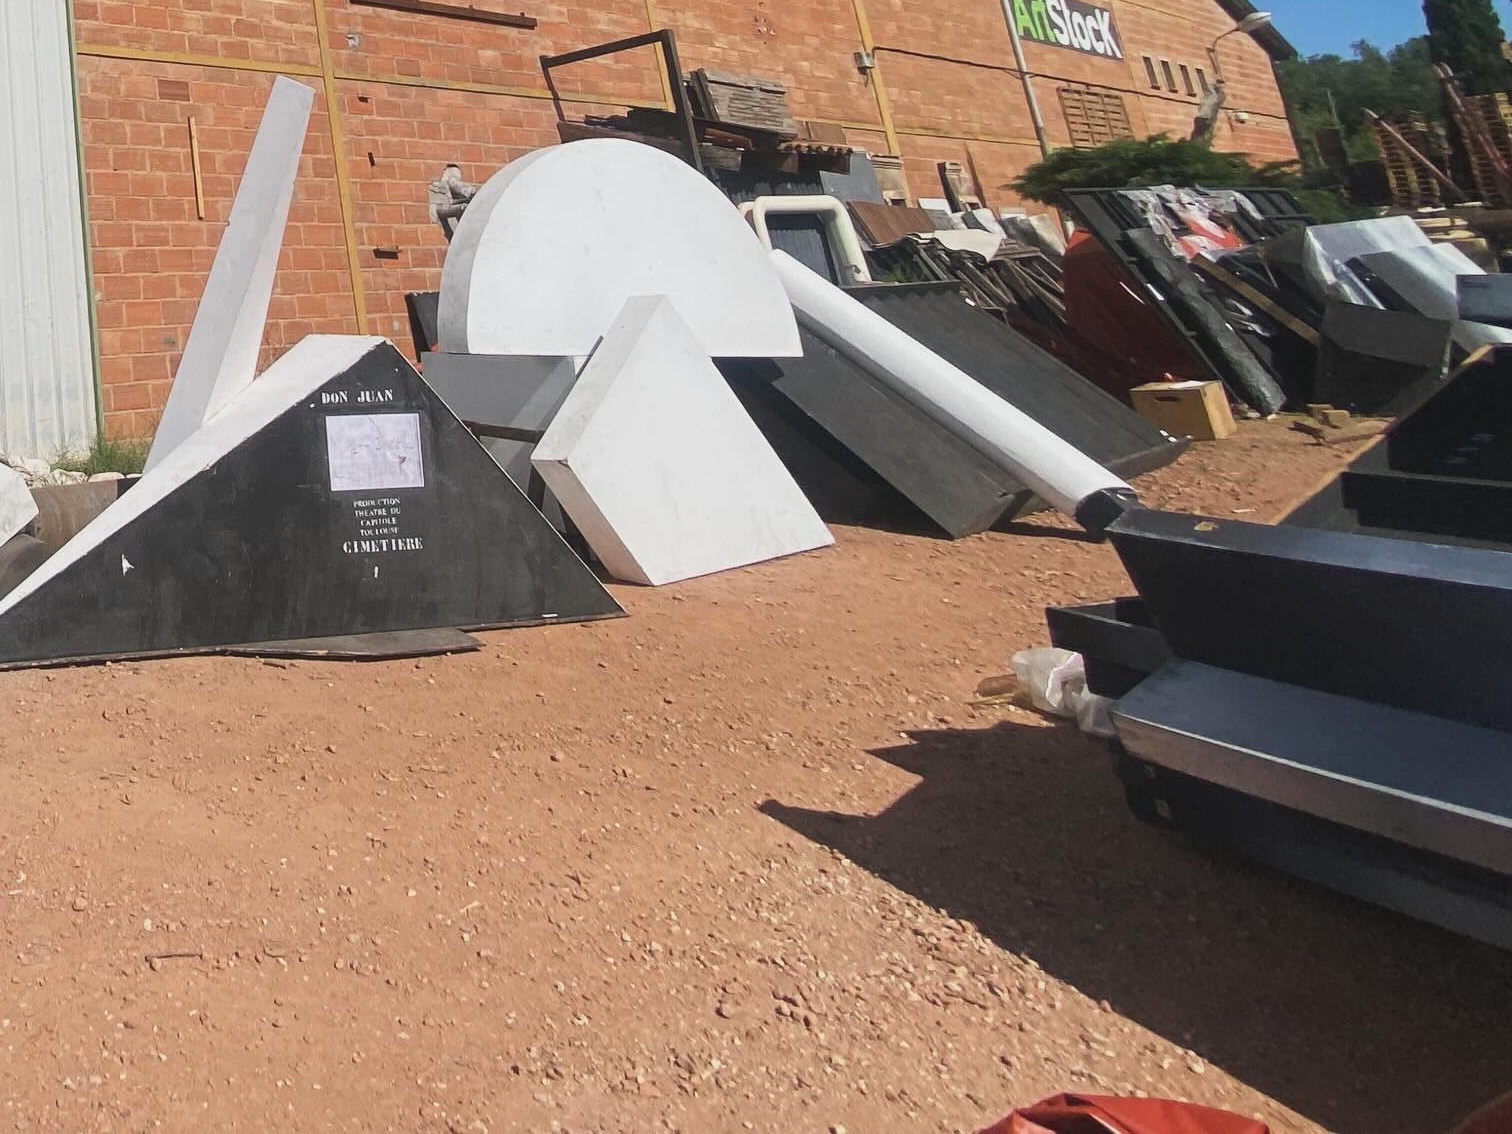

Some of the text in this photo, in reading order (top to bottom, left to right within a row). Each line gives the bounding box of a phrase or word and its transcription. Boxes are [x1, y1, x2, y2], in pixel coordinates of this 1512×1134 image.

[321, 389, 394, 404] DON JUAN
[353, 498, 401, 508] PRODUCTION
[354, 507, 401, 517] THEATRE DU
[360, 517, 397, 526] CAPITOLE
[342, 537, 423, 553] CIMETIERE
